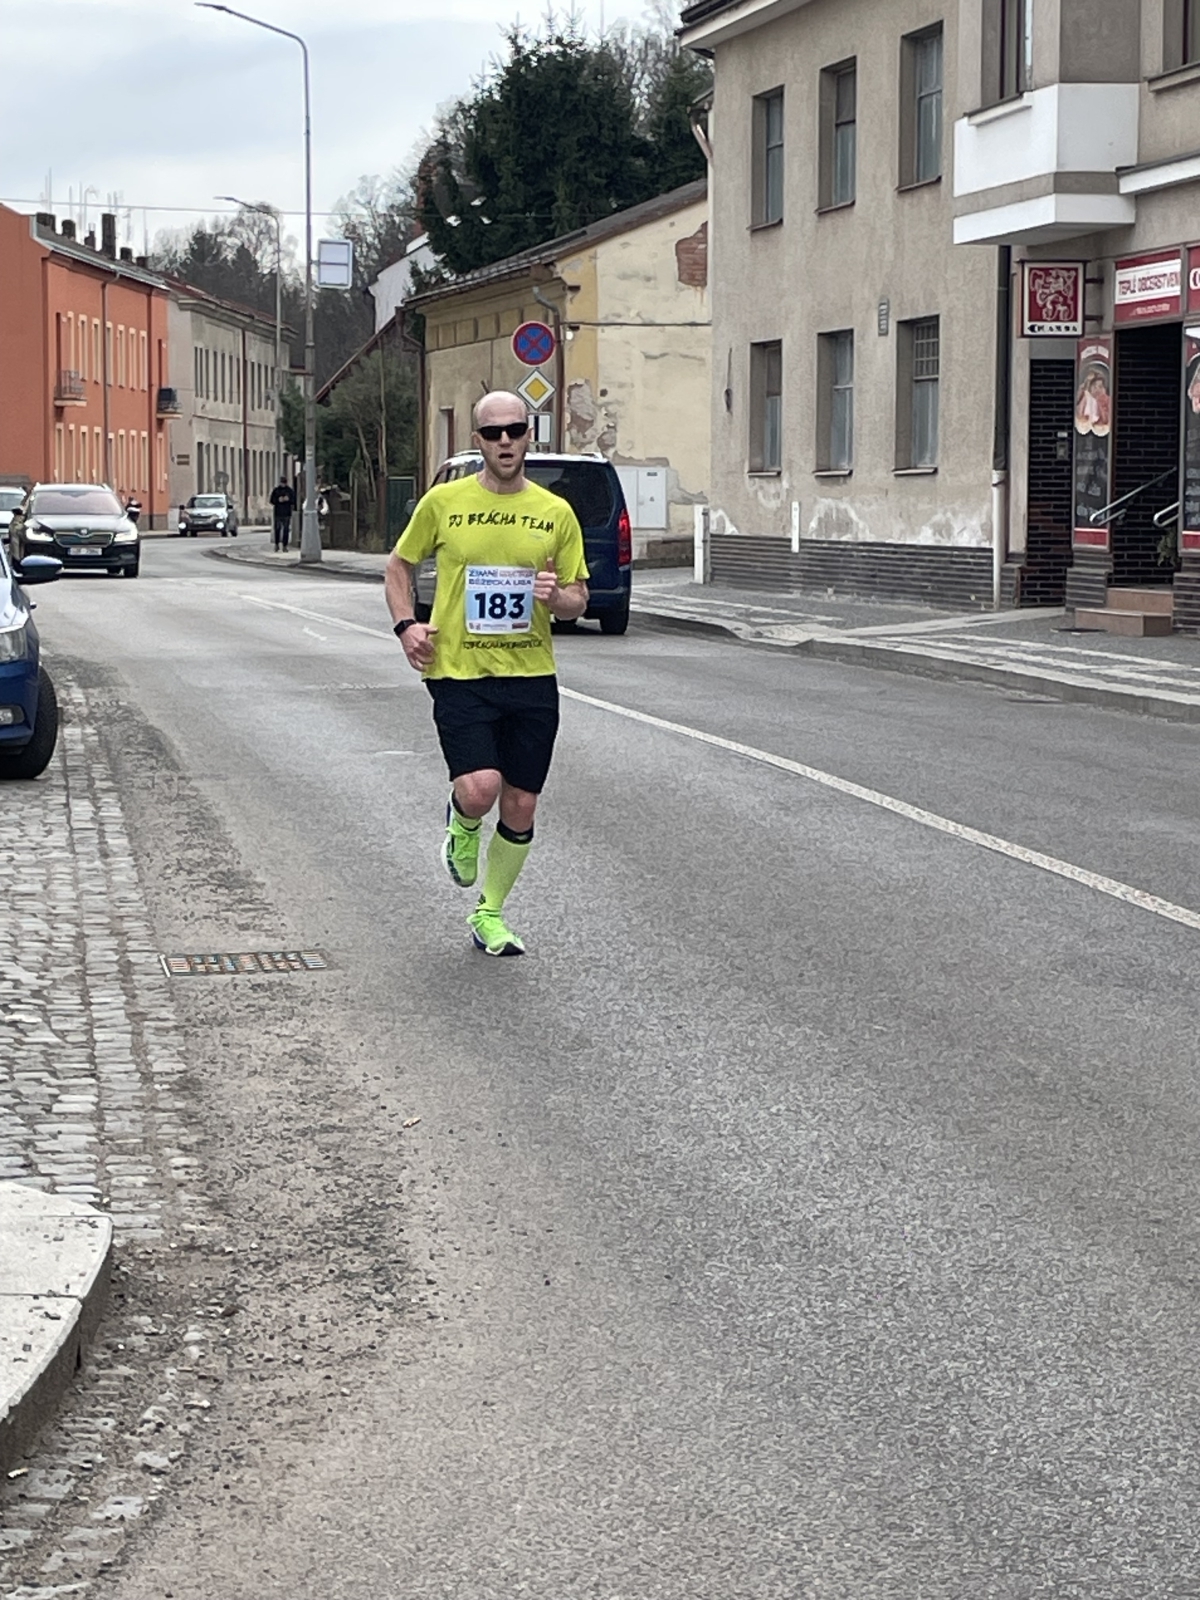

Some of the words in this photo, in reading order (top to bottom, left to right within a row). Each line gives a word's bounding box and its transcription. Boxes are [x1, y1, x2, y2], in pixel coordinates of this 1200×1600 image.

[448, 514, 463, 528] DJ
[468, 509, 516, 526] BRÁCHA
[521, 515, 554, 533] TEAM
[474, 592, 526, 620] 183
